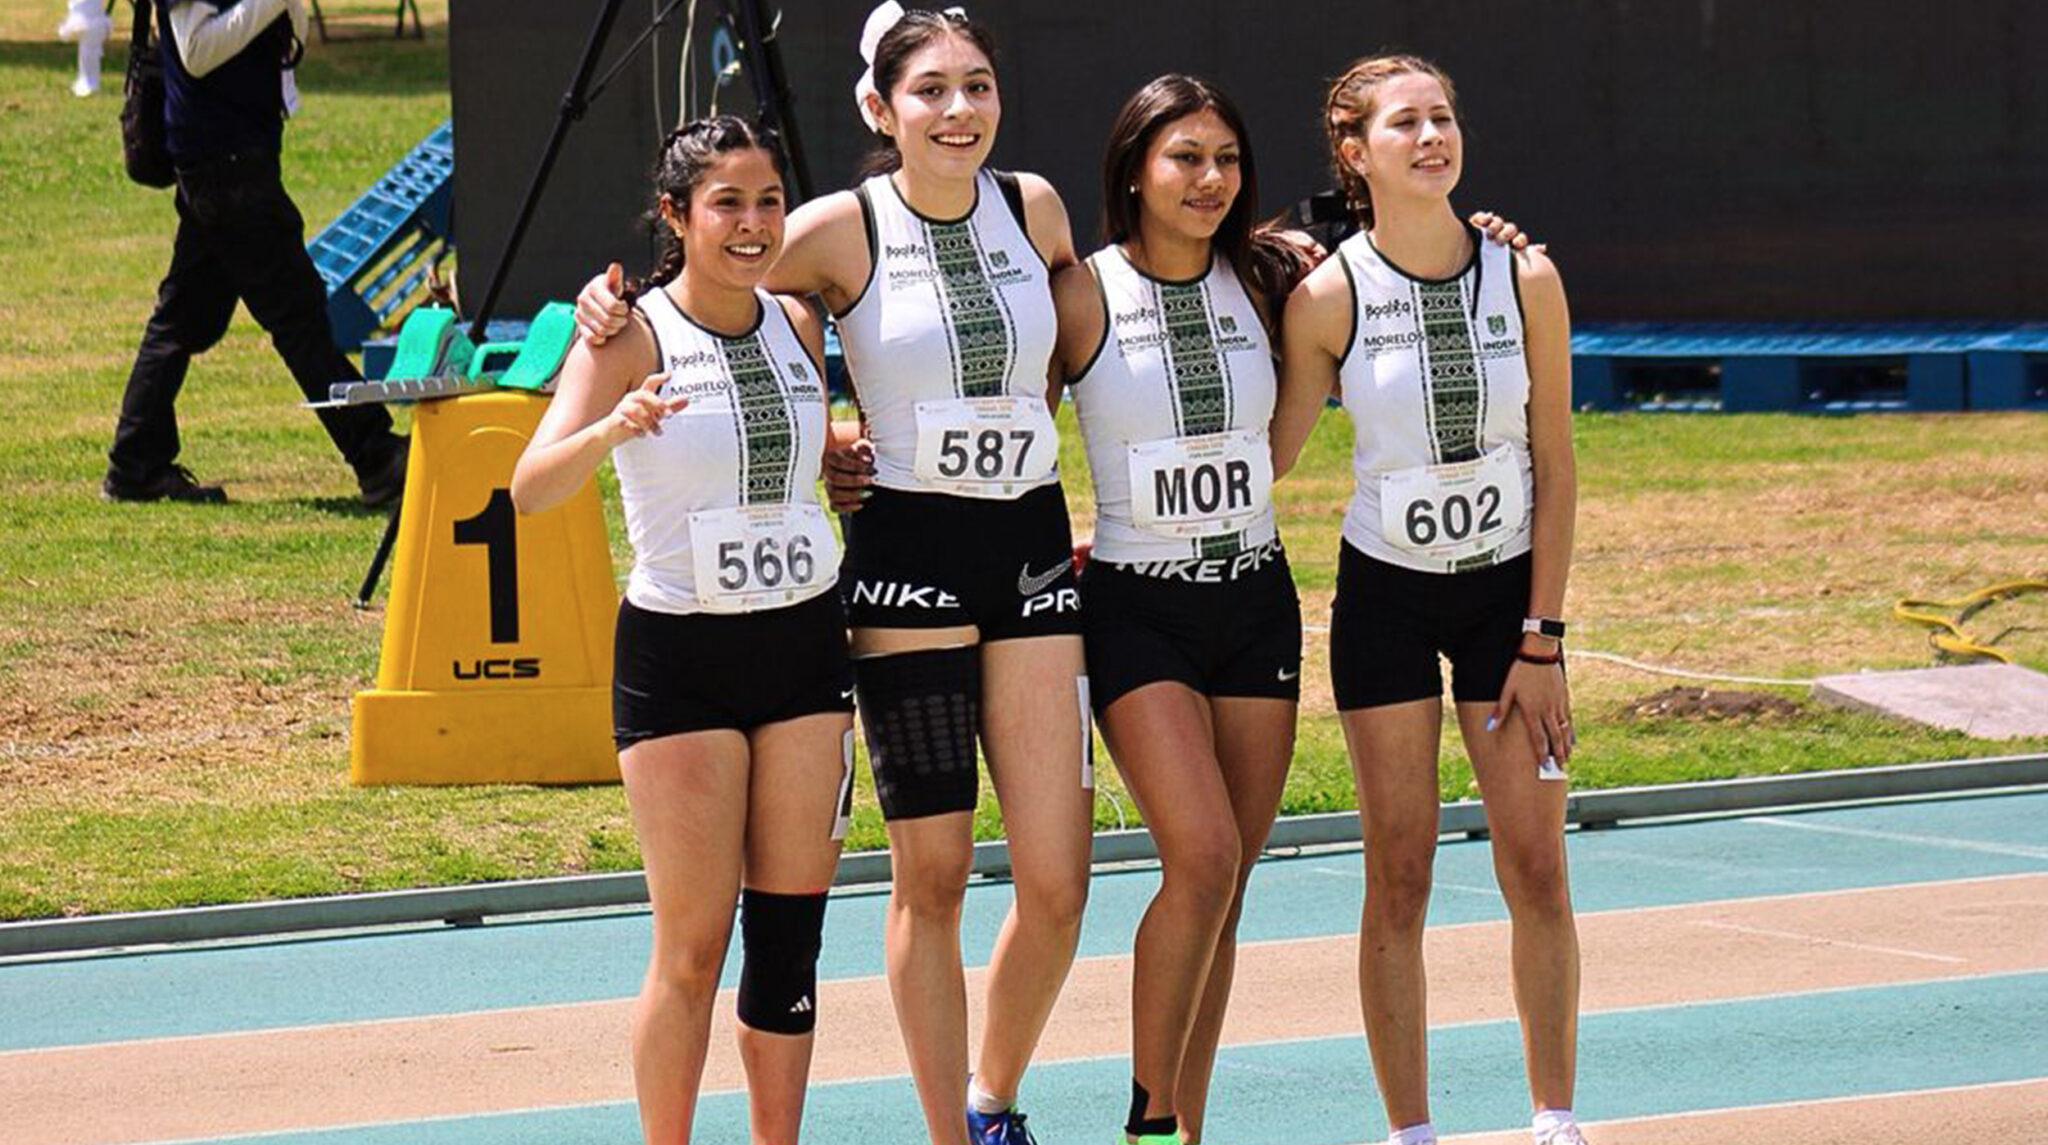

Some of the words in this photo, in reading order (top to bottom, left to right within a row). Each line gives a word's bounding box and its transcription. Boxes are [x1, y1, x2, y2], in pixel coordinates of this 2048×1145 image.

[938, 429, 1035, 478] 587
[1154, 460, 1252, 517] MOR
[1406, 485, 1502, 545] 602
[453, 488, 519, 643] 1
[718, 535, 814, 590] 566
[853, 580, 960, 608] NIKE
[1022, 588, 1080, 617] PR
[453, 658, 541, 679] UCS
